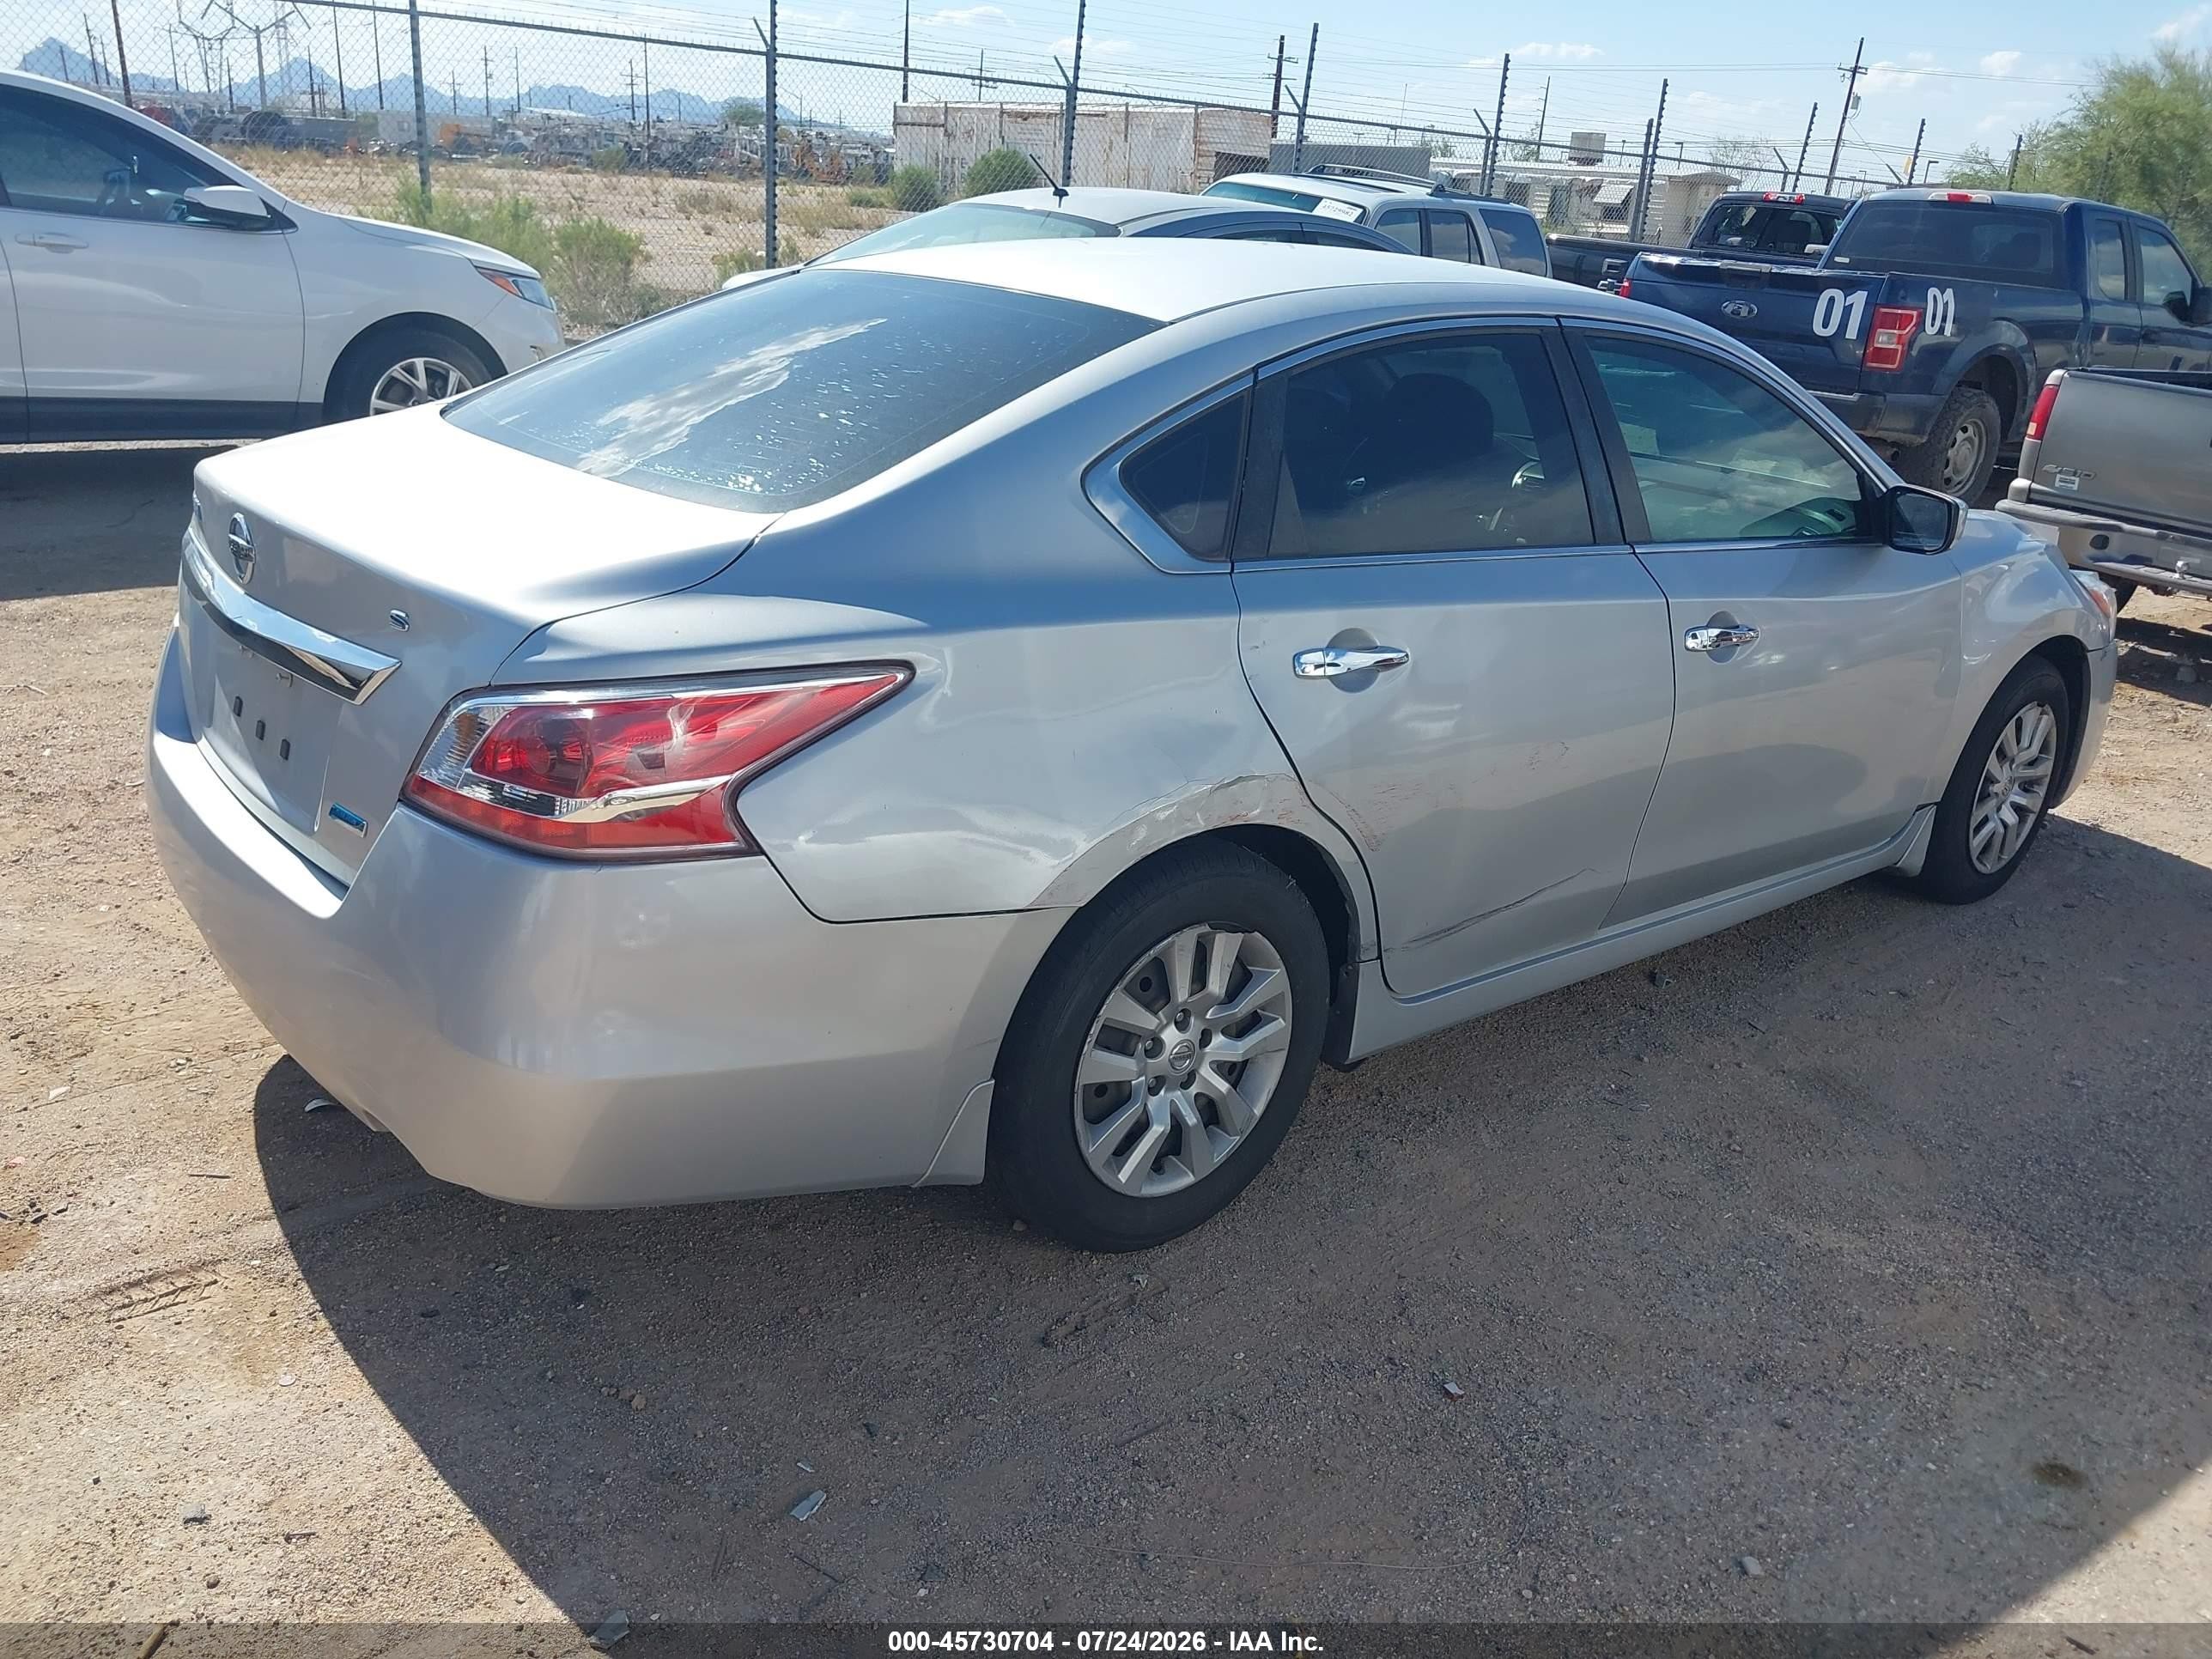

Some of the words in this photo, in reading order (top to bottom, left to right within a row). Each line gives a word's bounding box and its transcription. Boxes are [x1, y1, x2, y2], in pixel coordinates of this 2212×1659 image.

[1813, 288, 1869, 340] 01
[1924, 287, 1955, 337] 01
[390, 609, 409, 632] S
